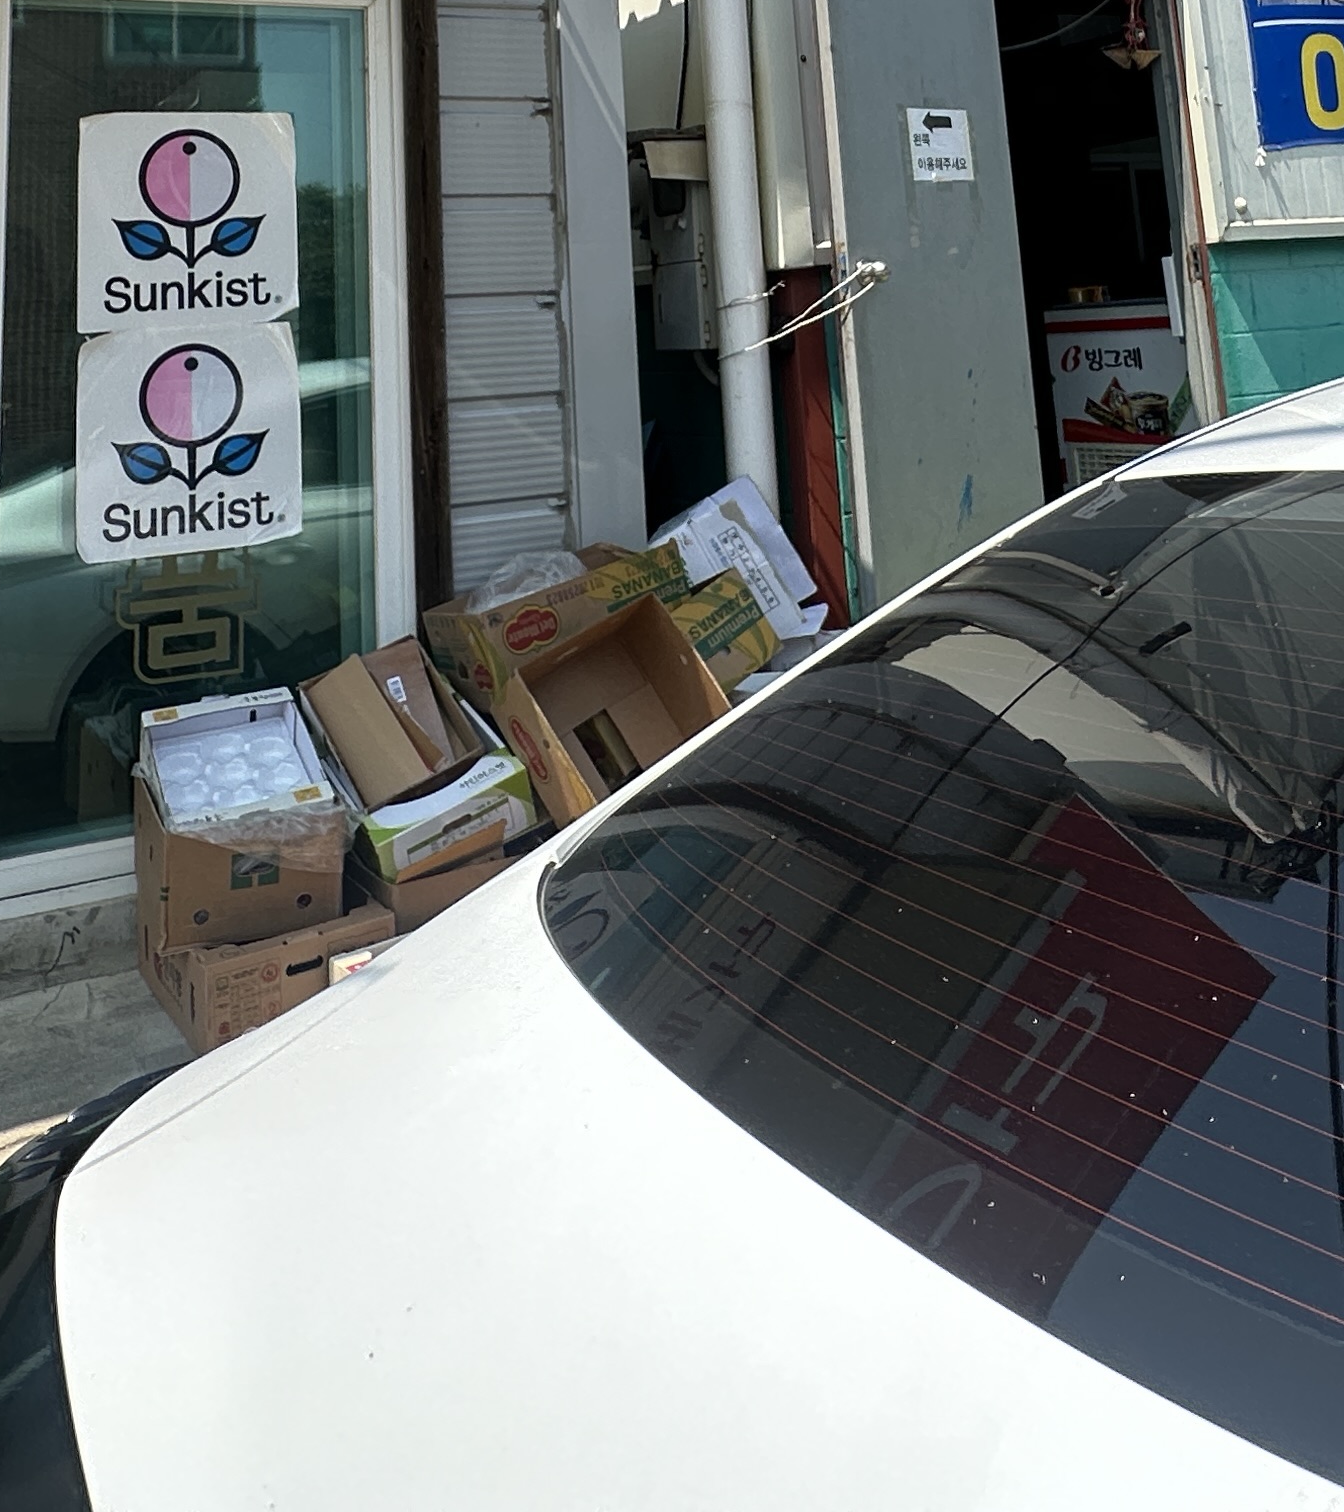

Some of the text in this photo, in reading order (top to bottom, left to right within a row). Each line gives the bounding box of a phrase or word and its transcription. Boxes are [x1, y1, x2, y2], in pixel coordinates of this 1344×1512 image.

[104, 271, 272, 314] Sunkist
[1084, 346, 1144, 372] 빙그레
[103, 491, 274, 543] Sunkist
[612, 554, 686, 600] BANANAS
[687, 587, 753, 640] BANANAS
[707, 605, 761, 650] Premium
